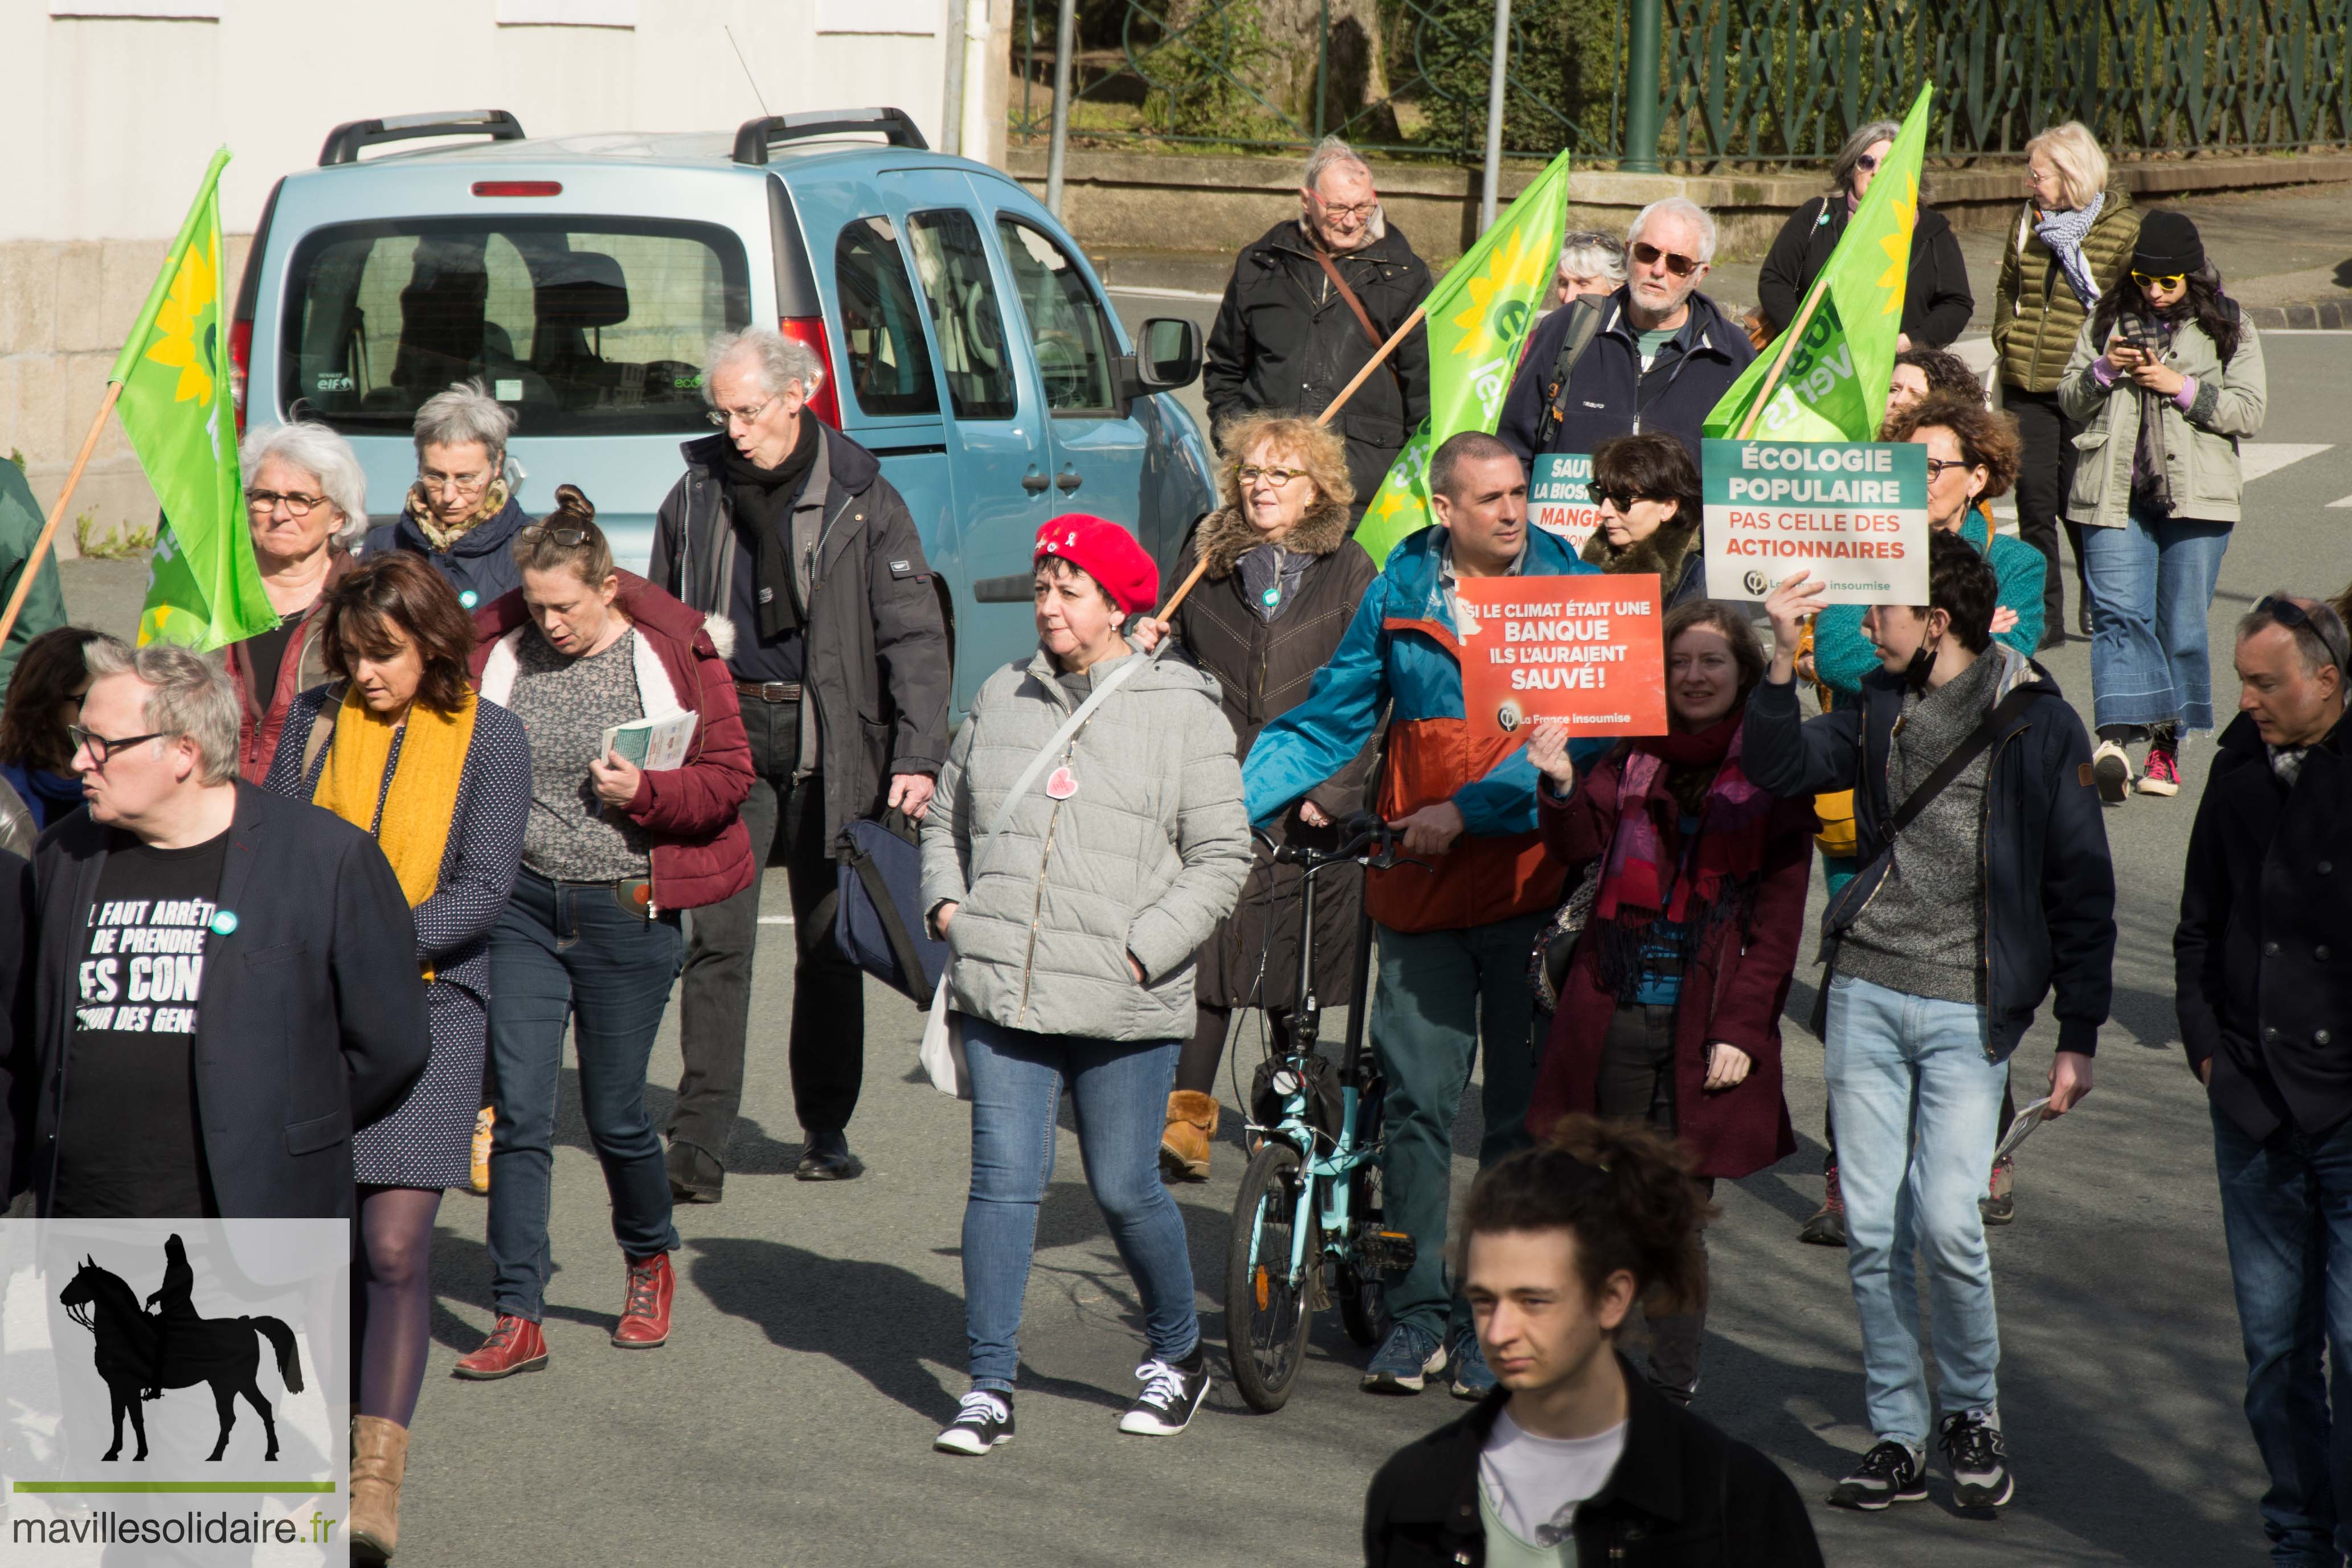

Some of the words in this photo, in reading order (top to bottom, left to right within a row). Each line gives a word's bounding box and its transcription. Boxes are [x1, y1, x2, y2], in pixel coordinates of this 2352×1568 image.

[317, 379, 339, 390] elf
[1742, 442, 1892, 472] ÉCOLOGIE
[1534, 483, 1548, 499] LA
[1729, 478, 1900, 504] POPULAIRE
[1729, 512, 1770, 529] PAS
[1778, 513, 1846, 531] CELLE
[1854, 515, 1900, 532] DES
[1726, 538, 1904, 559] ACTIONNAIRES
[1829, 580, 1891, 591] insoumise
[1483, 604, 1501, 618] LE
[1504, 603, 1561, 617] CLIMAT
[1566, 600, 1610, 616] ÉTAIT
[1615, 601, 1650, 615] UNE
[1505, 620, 1609, 642] BANQUE
[1490, 648, 1515, 664] ILS
[1520, 645, 1627, 664] L'AURAIENT
[1519, 715, 1531, 724] La
[1572, 713, 1631, 724] insoumise
[97, 901, 150, 926] FAUT
[90, 929, 117, 954] DE
[118, 928, 206, 954] PRENDRE
[113, 1007, 150, 1032] DES
